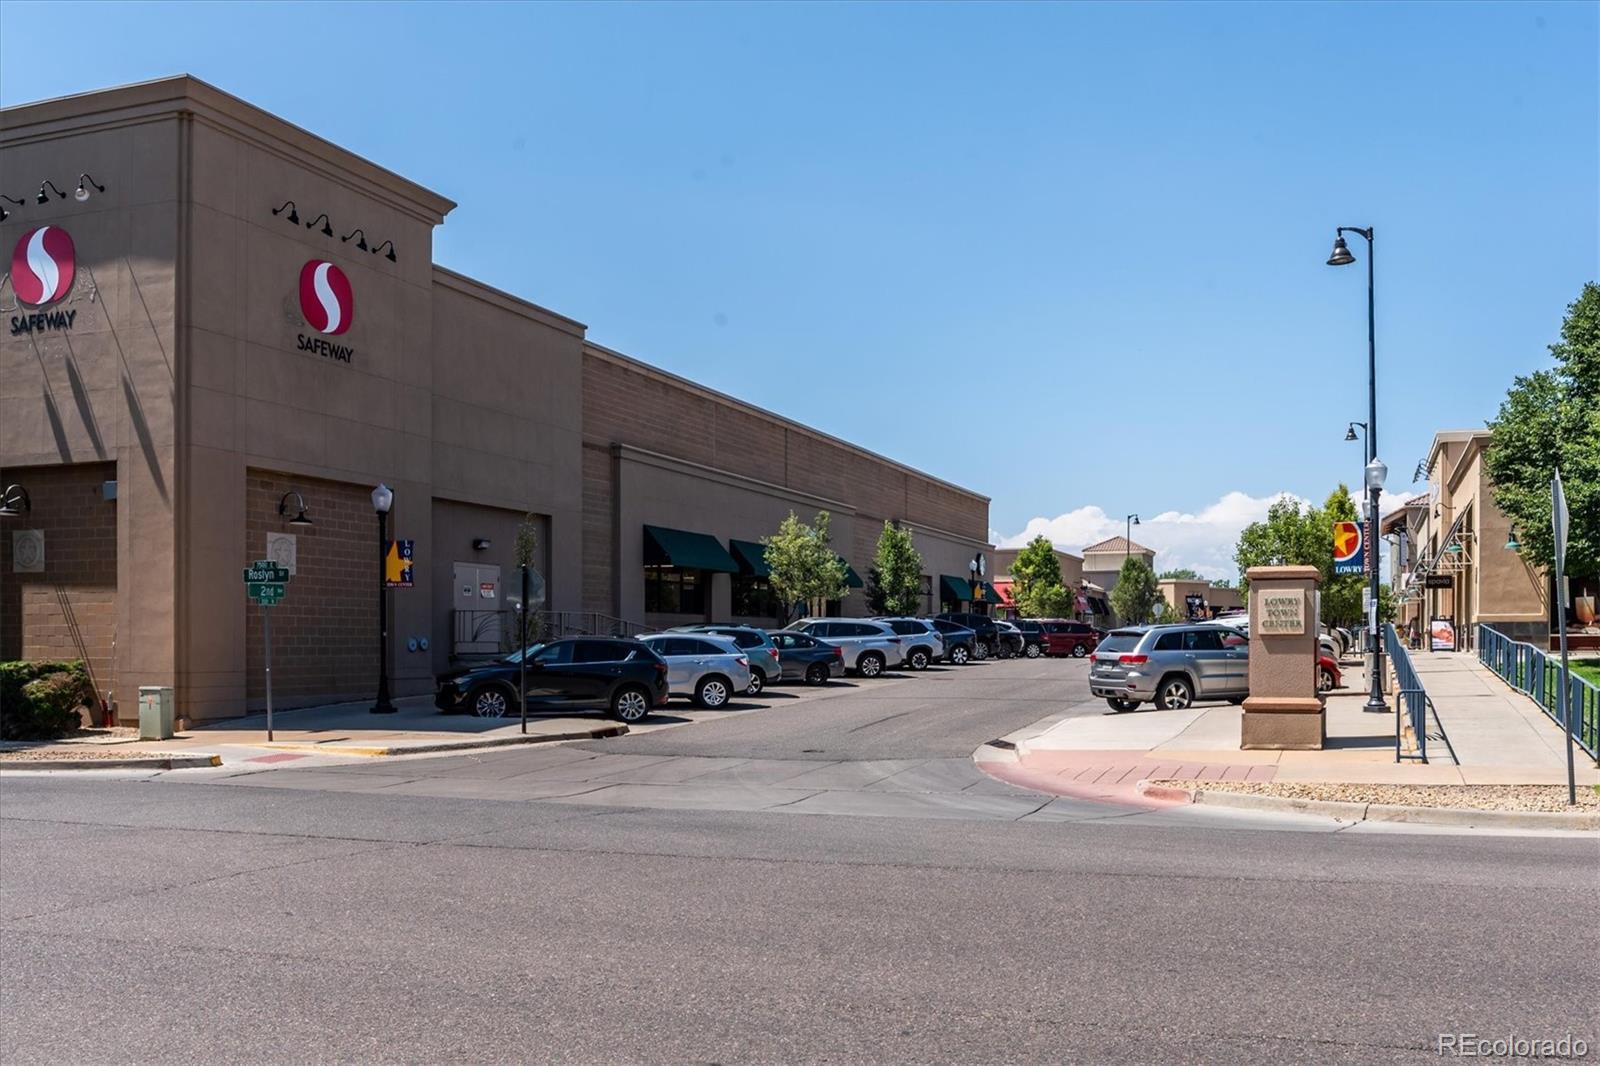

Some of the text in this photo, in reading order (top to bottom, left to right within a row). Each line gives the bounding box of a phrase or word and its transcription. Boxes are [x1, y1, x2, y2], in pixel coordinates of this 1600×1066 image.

[11, 310, 76, 334] SAFEWAY
[297, 334, 354, 363] SAFEWAY
[1335, 565, 1362, 573] LOWRY
[248, 570, 275, 582] Roslyn
[261, 586, 275, 597] 2nd
[1264, 597, 1301, 607] LOWRY
[1266, 608, 1299, 617] TOWN
[1262, 619, 1303, 628] CENTER
